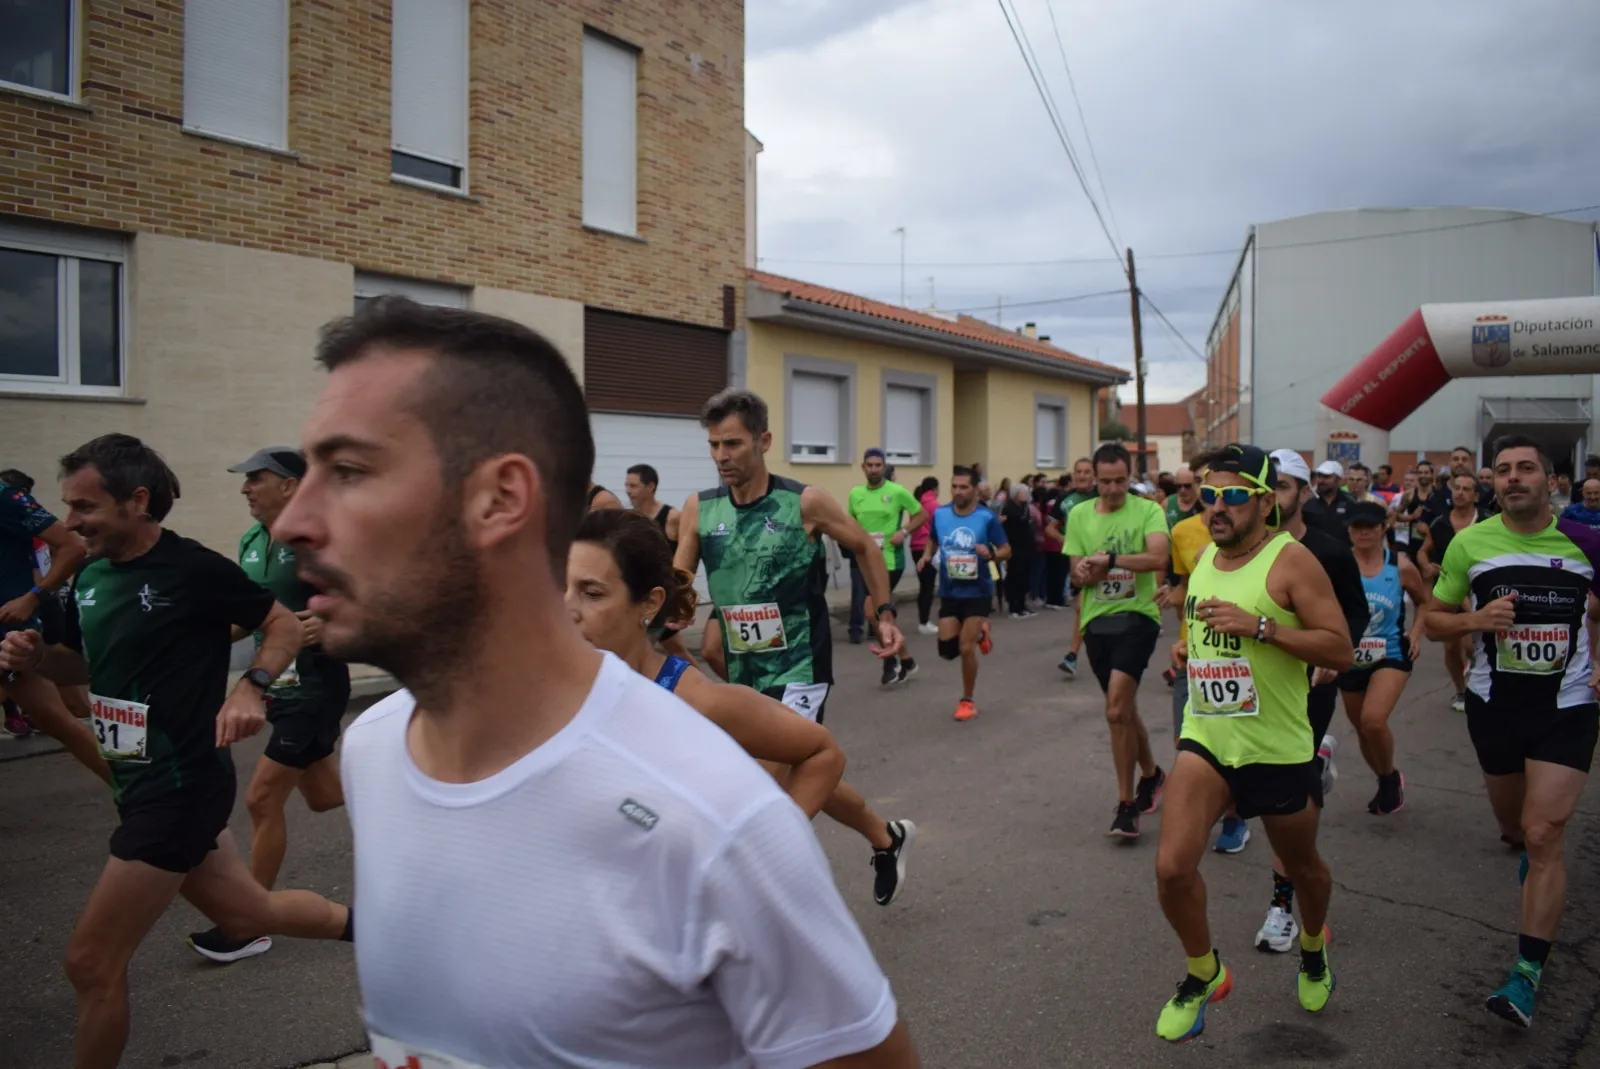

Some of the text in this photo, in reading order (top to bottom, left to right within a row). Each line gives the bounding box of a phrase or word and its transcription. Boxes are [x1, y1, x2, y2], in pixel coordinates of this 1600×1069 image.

[1513, 317, 1593, 335] Diputación
[1513, 348, 1525, 357] de
[1340, 336, 1427, 414] CON EL DEPORTE
[955, 563, 967, 572] 92
[1103, 582, 1121, 594] 29
[722, 607, 780, 621] bedunia
[740, 622, 762, 641] 51
[1355, 649, 1373, 662] 26
[1511, 642, 1556, 662] 100
[1189, 662, 1251, 679] bedunia
[1200, 680, 1240, 703] 109
[91, 700, 145, 728] dunia
[95, 719, 119, 749] 31
